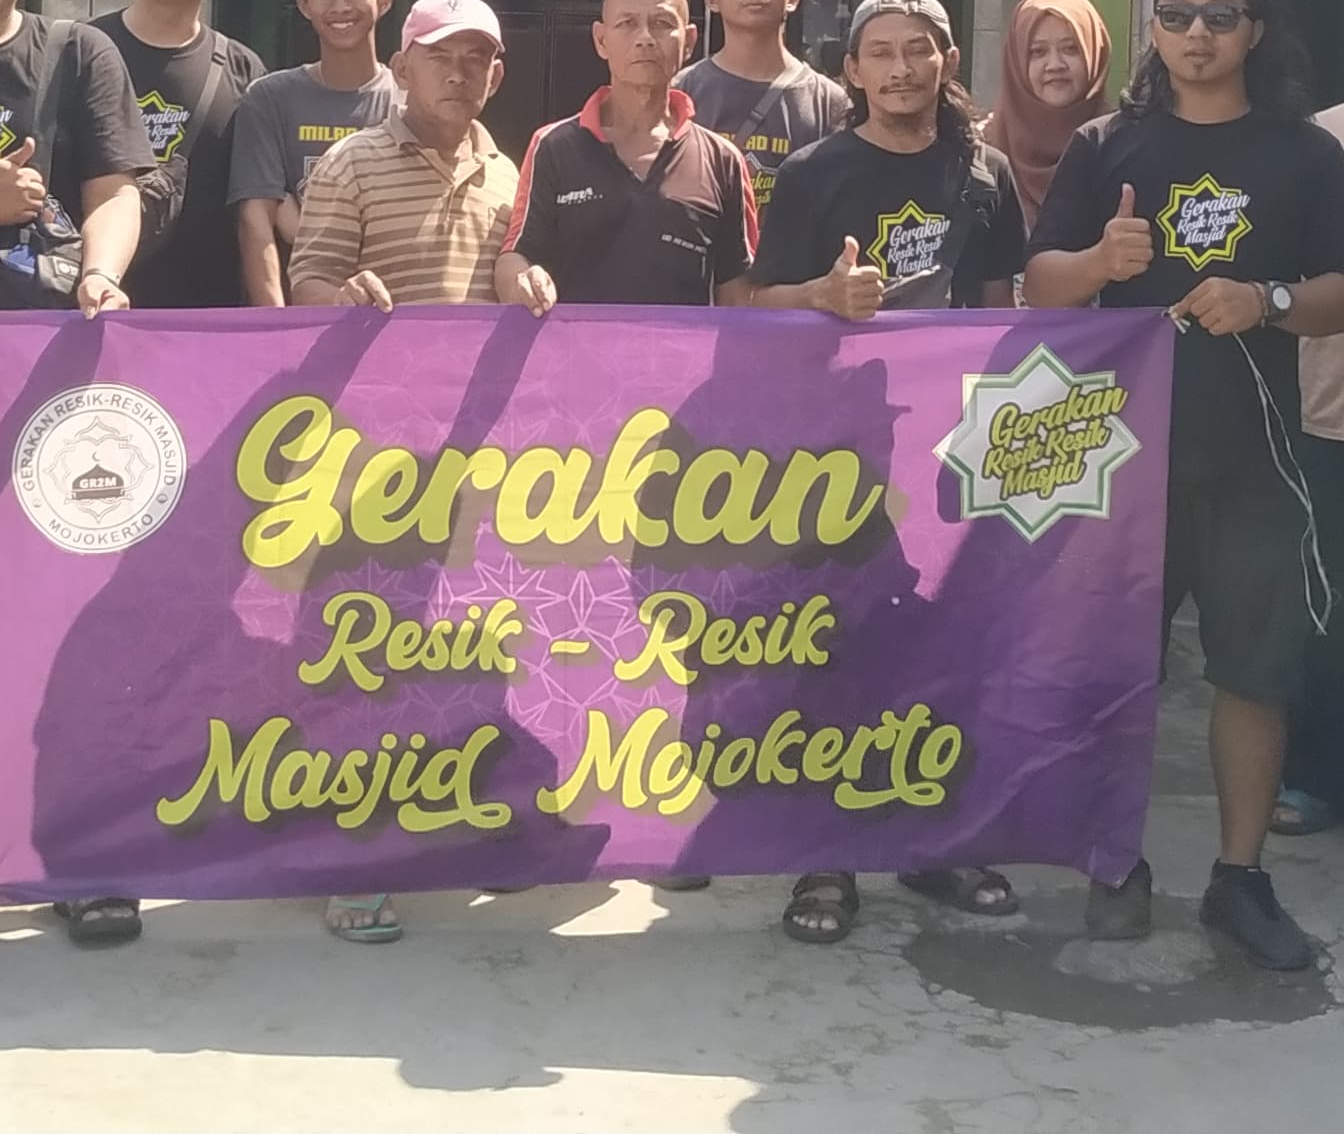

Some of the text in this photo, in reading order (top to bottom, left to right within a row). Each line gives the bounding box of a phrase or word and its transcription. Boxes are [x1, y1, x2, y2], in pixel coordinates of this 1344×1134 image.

[1177, 209, 1239, 234] Resik Resik
[1181, 191, 1251, 221] Gerakan
[889, 218, 951, 249] Gerakan
[1184, 224, 1227, 248] Masjid
[896, 251, 934, 275] Masjid
[991, 385, 1128, 448] Gerakan
[20, 393, 178, 492] GERAKAN RESIK-RESIK MASJID
[982, 418, 1112, 480] Resik Resik
[79, 476, 118, 490] GR2M
[236, 395, 887, 570] Gerakan
[1000, 449, 1087, 501] Masjid
[47, 512, 154, 546] MOJOKERTO
[297, 589, 526, 693] Resik
[614, 586, 838, 689] Resik
[154, 702, 963, 834] Masjid Mojokerto
